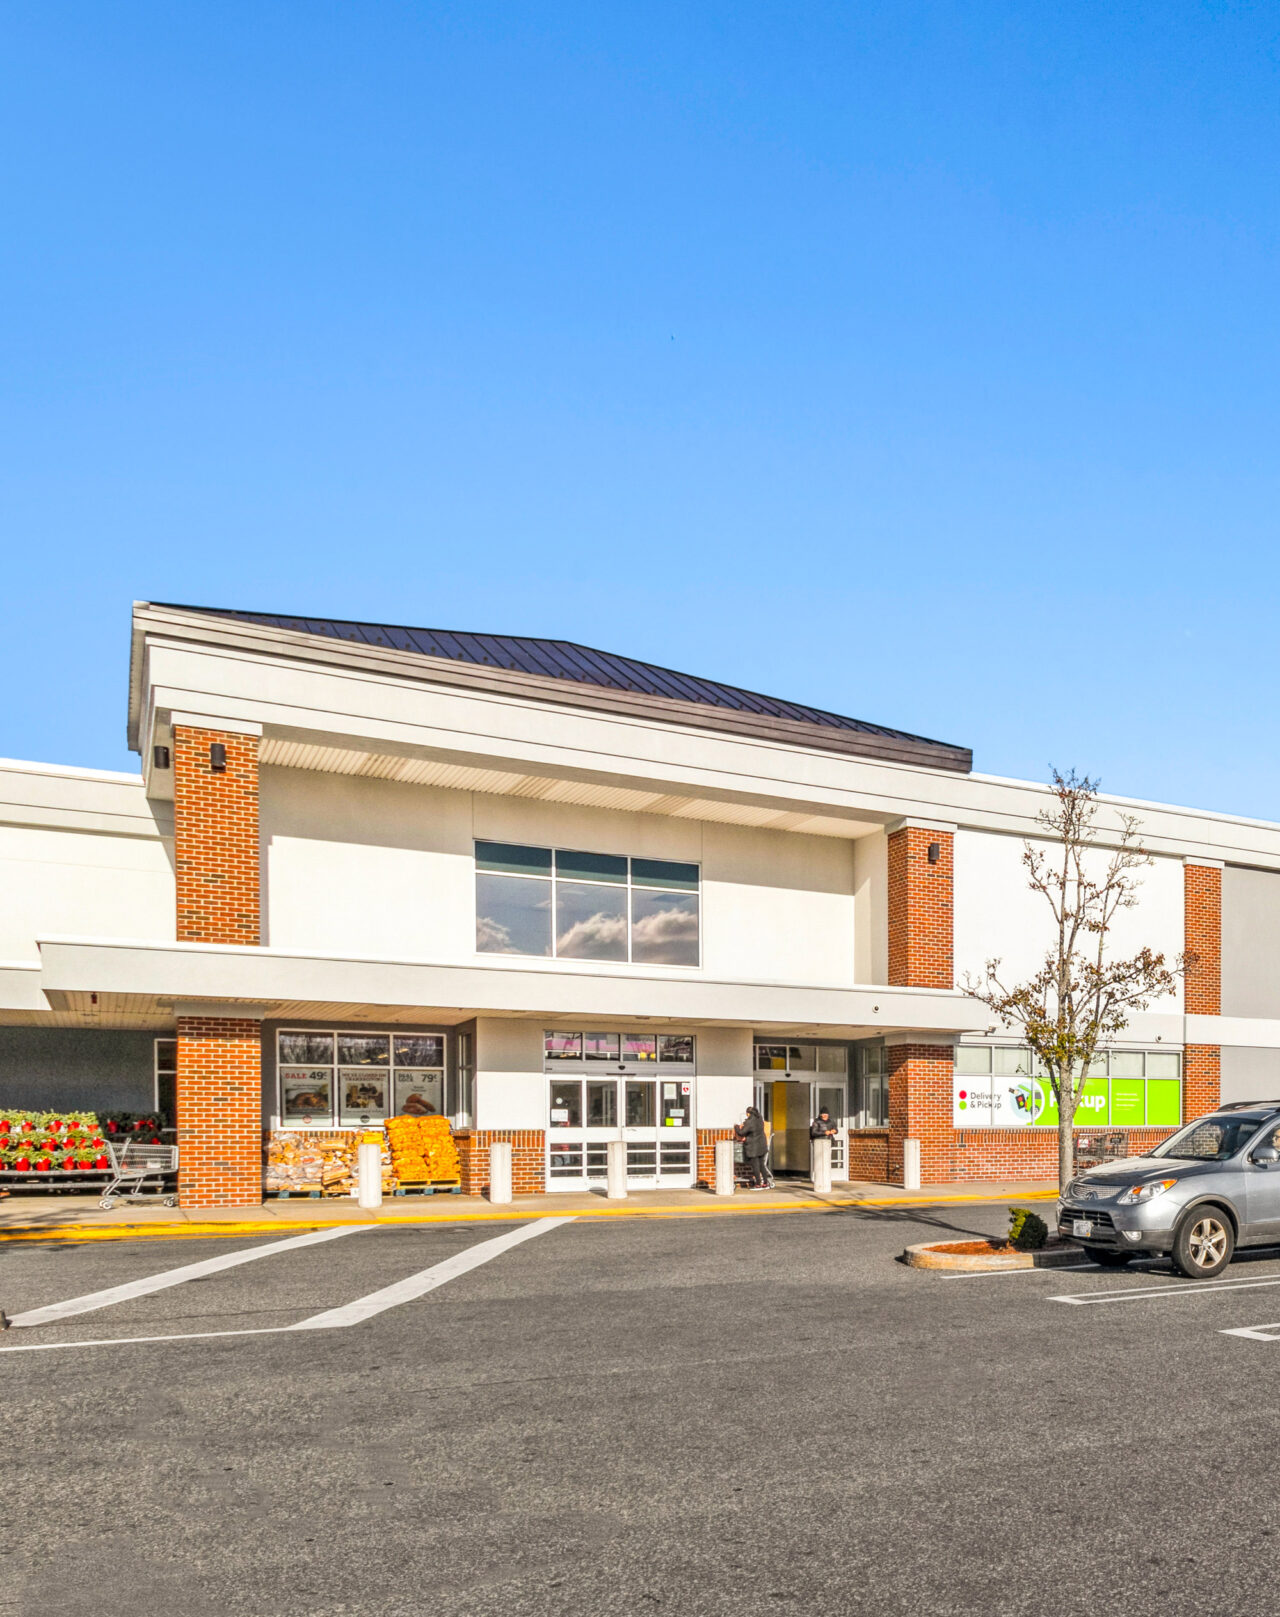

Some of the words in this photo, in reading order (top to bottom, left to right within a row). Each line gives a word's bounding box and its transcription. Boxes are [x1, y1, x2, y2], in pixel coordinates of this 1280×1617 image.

[970, 1092, 1002, 1102] Delivery
[970, 1101, 975, 1109] &
[977, 1101, 1002, 1110] Pickup
